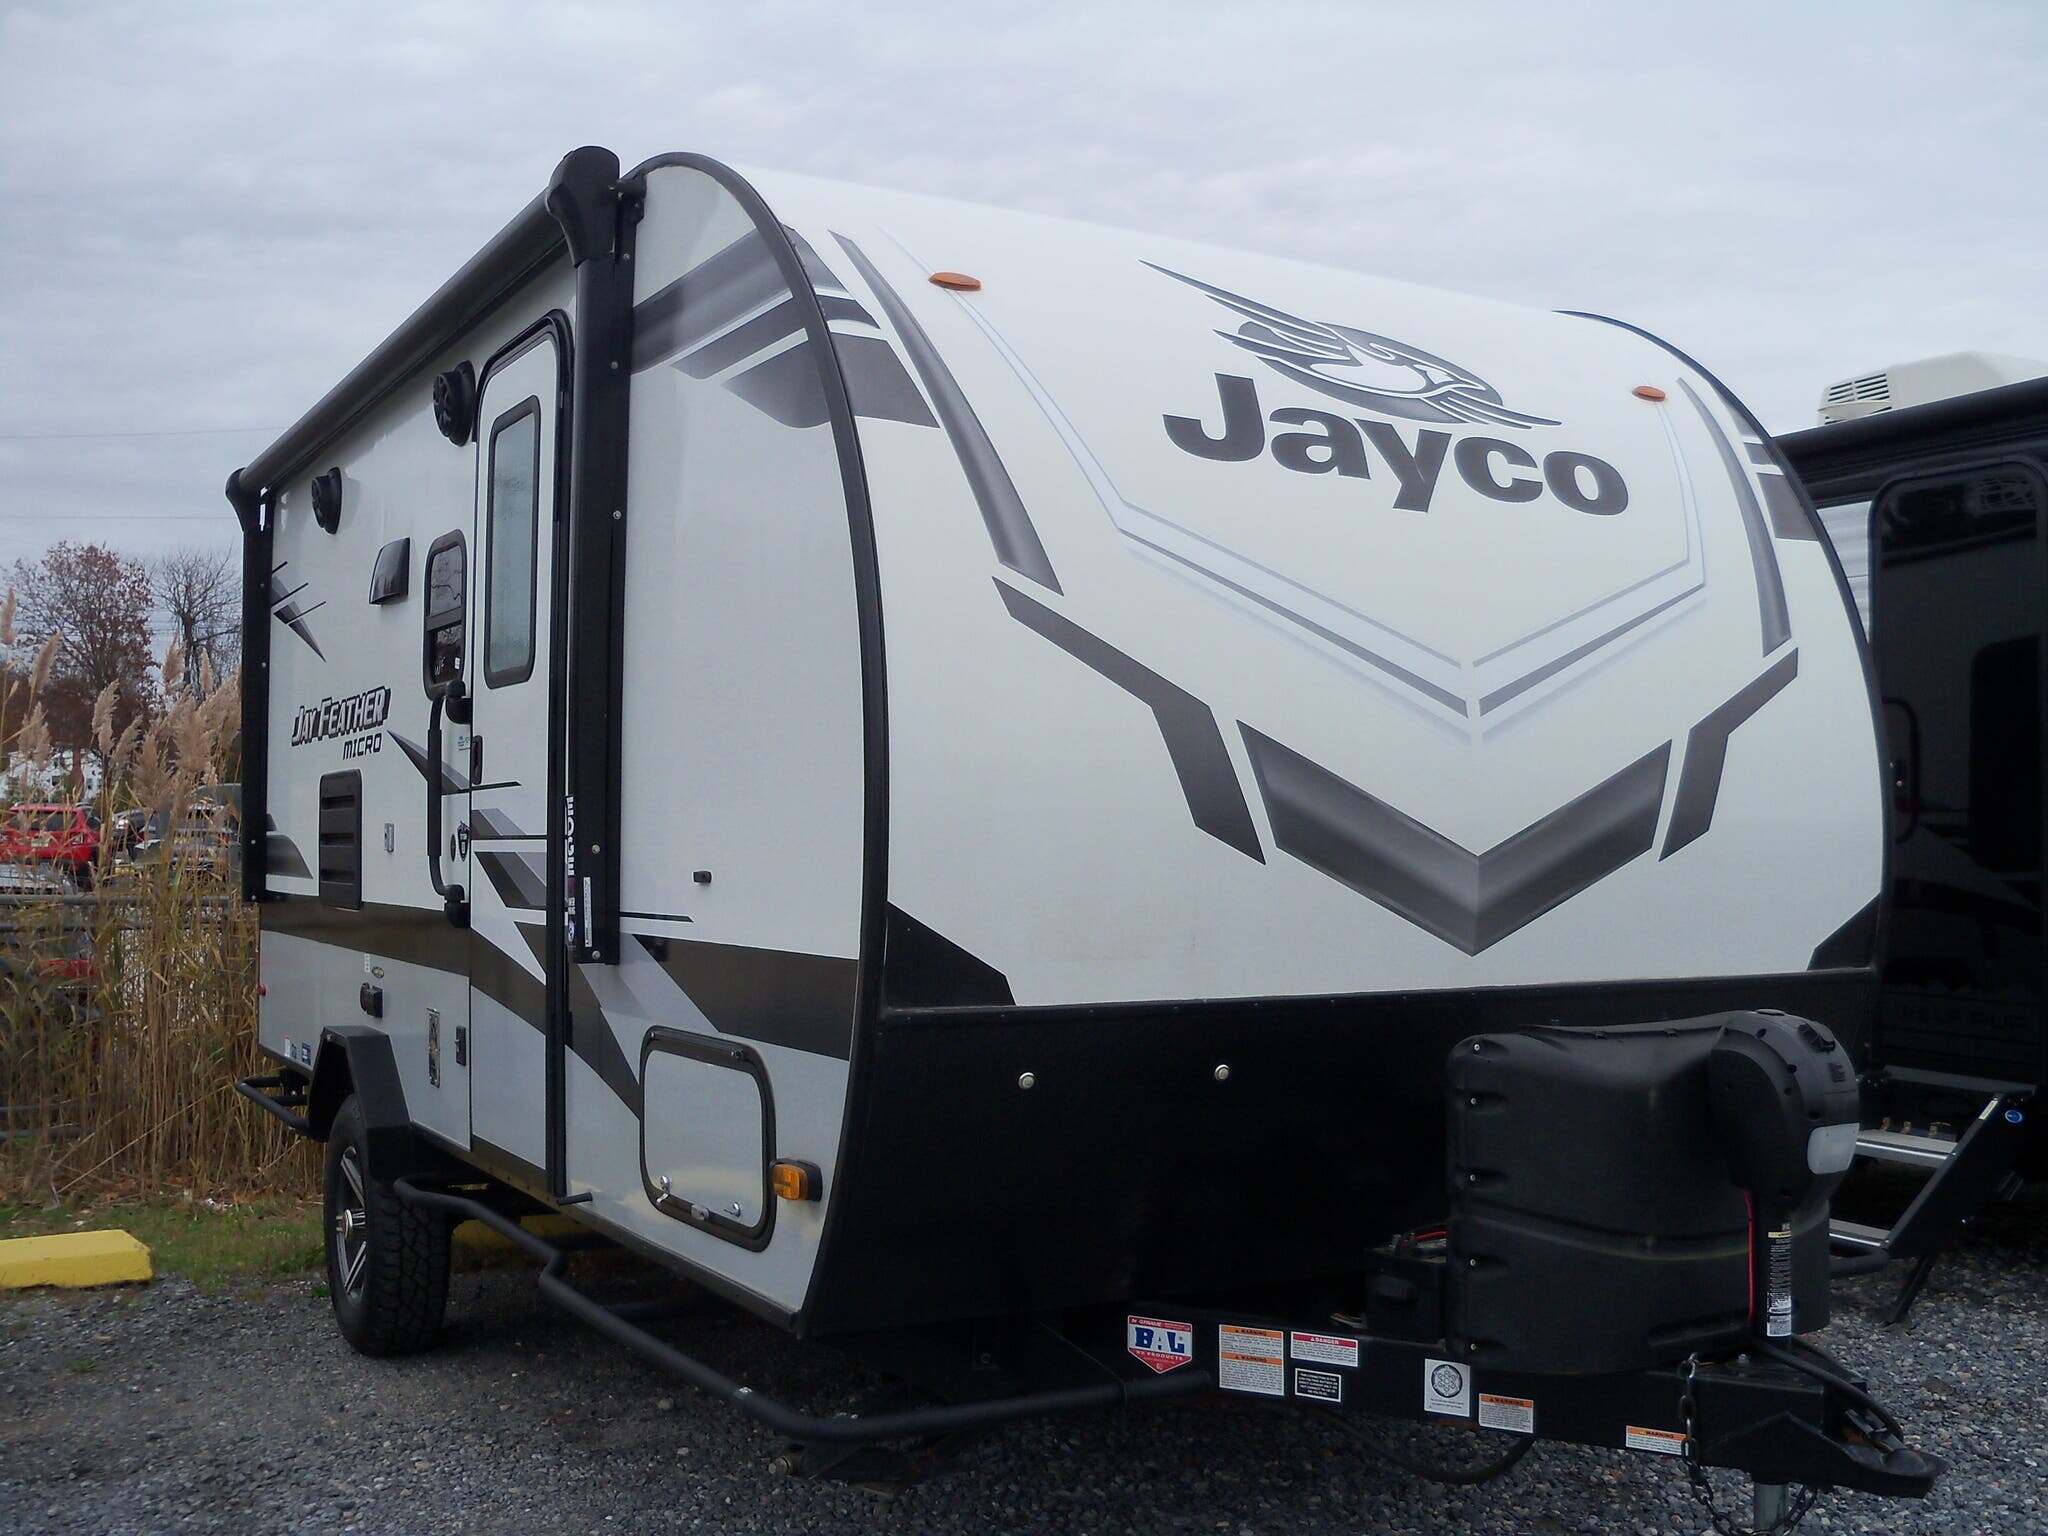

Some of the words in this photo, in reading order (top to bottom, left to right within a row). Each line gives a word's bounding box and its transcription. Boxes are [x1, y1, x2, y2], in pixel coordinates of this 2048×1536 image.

[1162, 372, 1630, 516] Jayco
[292, 705, 320, 747] JAY
[317, 686, 391, 741] FEATHER
[343, 733, 382, 760] MICRO
[1135, 1326, 1185, 1354] BAL
